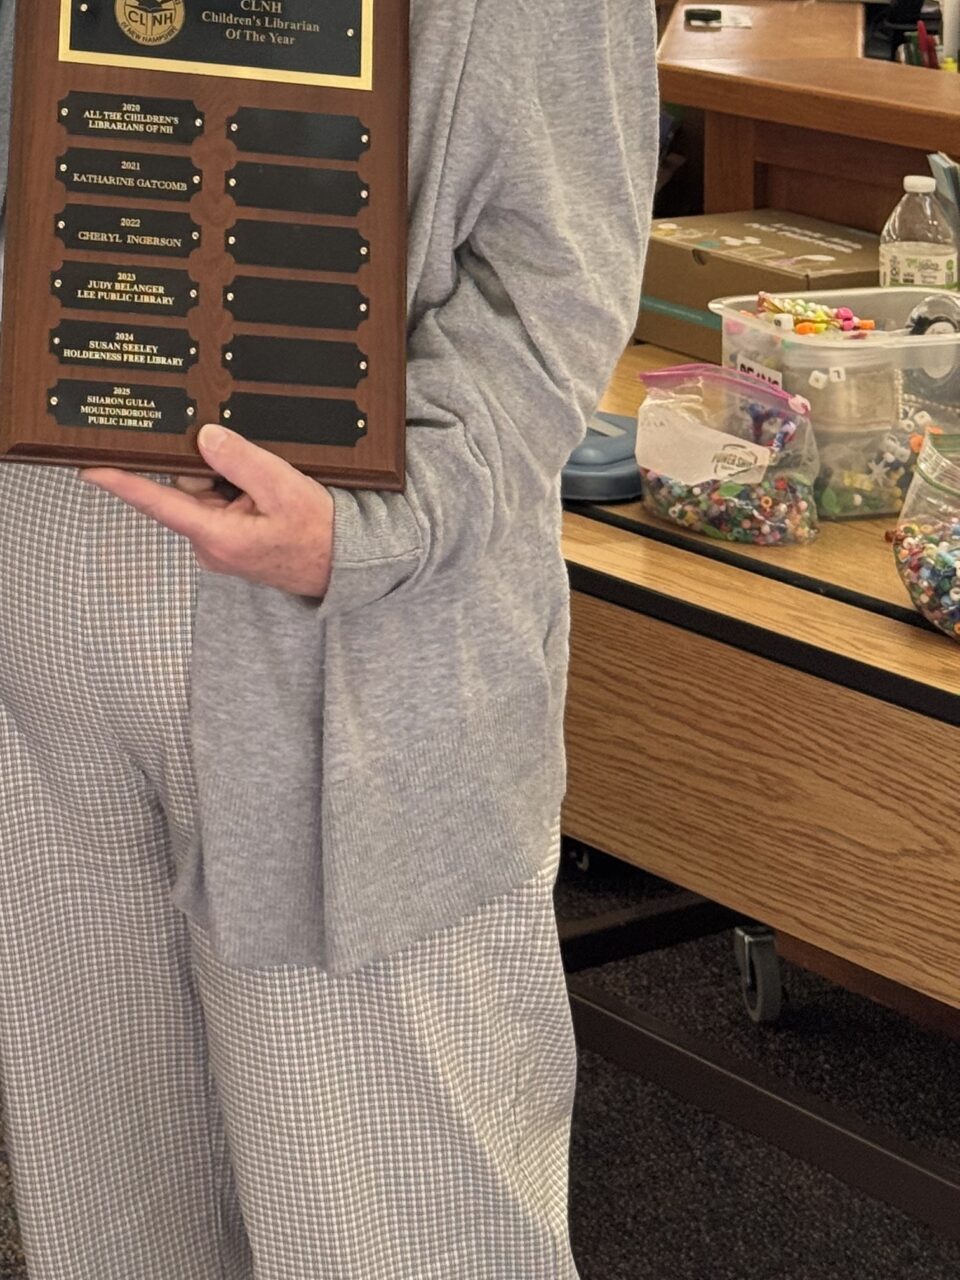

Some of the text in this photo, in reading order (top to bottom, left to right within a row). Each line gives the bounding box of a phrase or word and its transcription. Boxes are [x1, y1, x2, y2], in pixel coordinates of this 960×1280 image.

[201, 11, 320, 32] Children's Librarian
[225, 28, 296, 45] Of The Year
[122, 103, 141, 112] 2020
[83, 110, 179, 125] ALL THE CHILDREN'S
[88, 120, 173, 135] LIBRARIANS OF NH
[121, 161, 140, 170] 2021
[72, 173, 188, 191] KATHARINE GATCOMB
[120, 218, 141, 227] 2022
[78, 231, 182, 247] CHERYL INGERSON
[117, 272, 136, 281] 2023
[87, 280, 165, 294] JUDY BELANGER
[77, 290, 175, 305] LEE PUBLIC LIBRARY
[115, 332, 134, 341] 2024
[89, 340, 159, 354] SUSAN SEELEY
[63, 349, 184, 366] HOLDERNESS FREE LIBRARY
[113, 387, 131, 396] 2025
[87, 395, 156, 408] SHARON GULLA
[80, 405, 162, 419] MOULTONBOROUGH
[88, 416, 155, 428] PUBLIC LIBRARY
